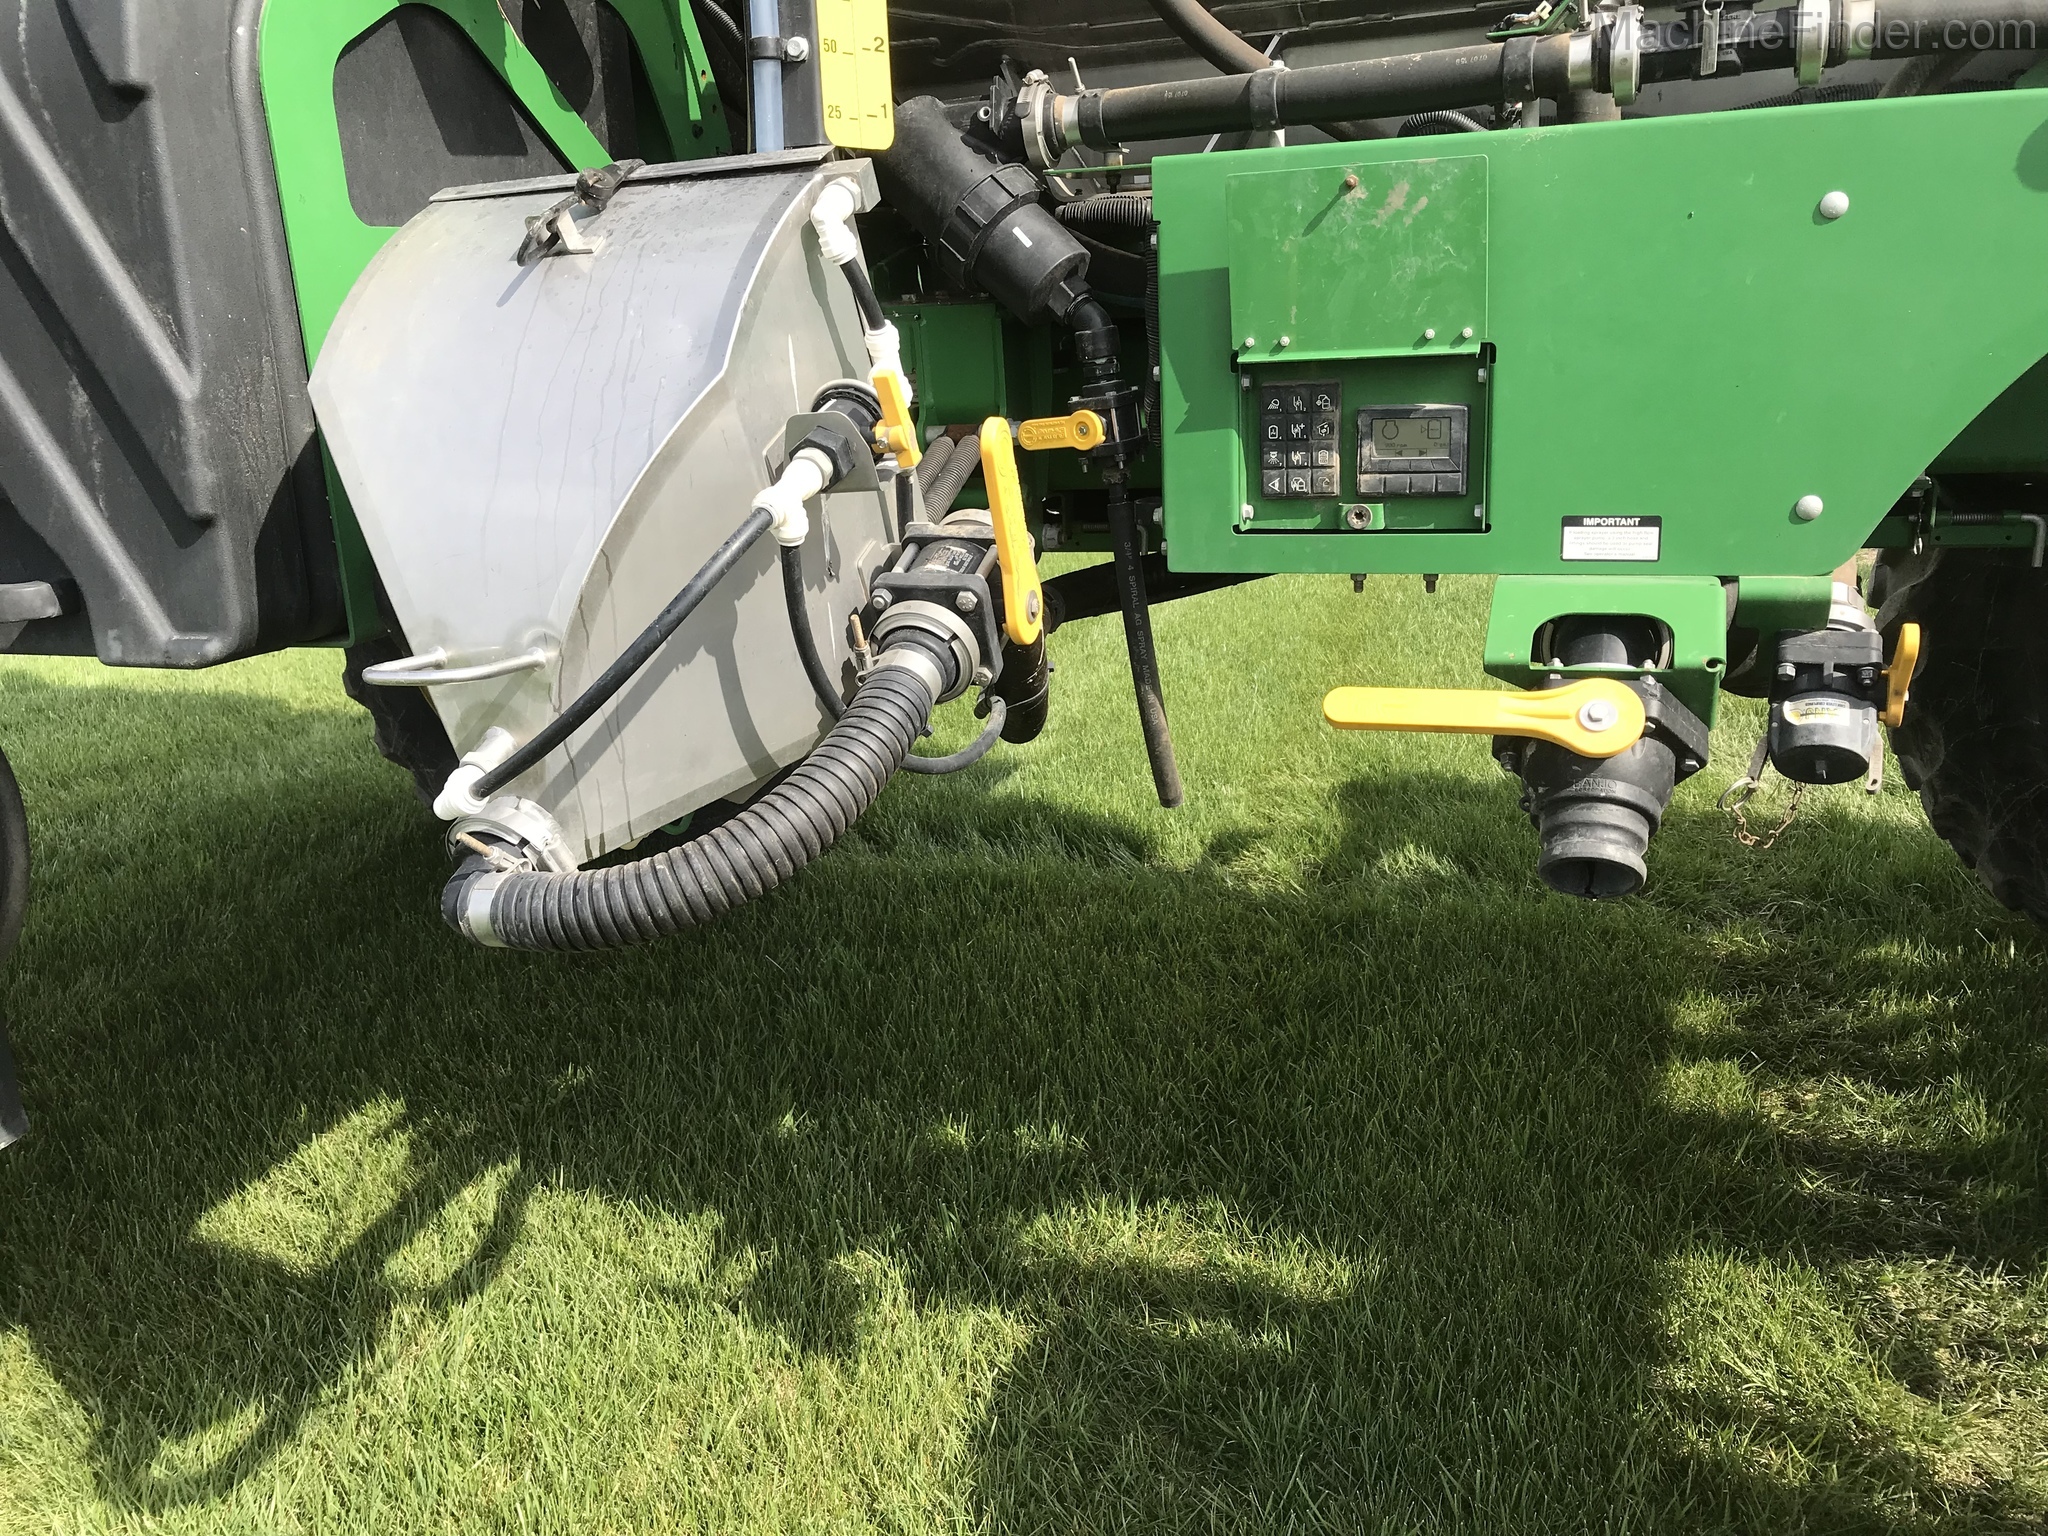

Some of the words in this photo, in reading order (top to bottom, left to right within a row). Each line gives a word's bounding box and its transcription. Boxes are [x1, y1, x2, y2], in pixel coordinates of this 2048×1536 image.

[823, 38, 837, 53] 50
[873, 36, 885, 53] 2
[827, 104, 842, 119] 25
[881, 103, 888, 119] 1
[1583, 518, 1641, 526] IMPORTANT
[1128, 575, 1139, 608] SPIRAL
[1134, 612, 1142, 626] AG
[1136, 630, 1148, 660] SPRAY
[1141, 665, 1153, 690] MADE
[1147, 694, 1155, 704] IN
[1149, 708, 1159, 726] USA
